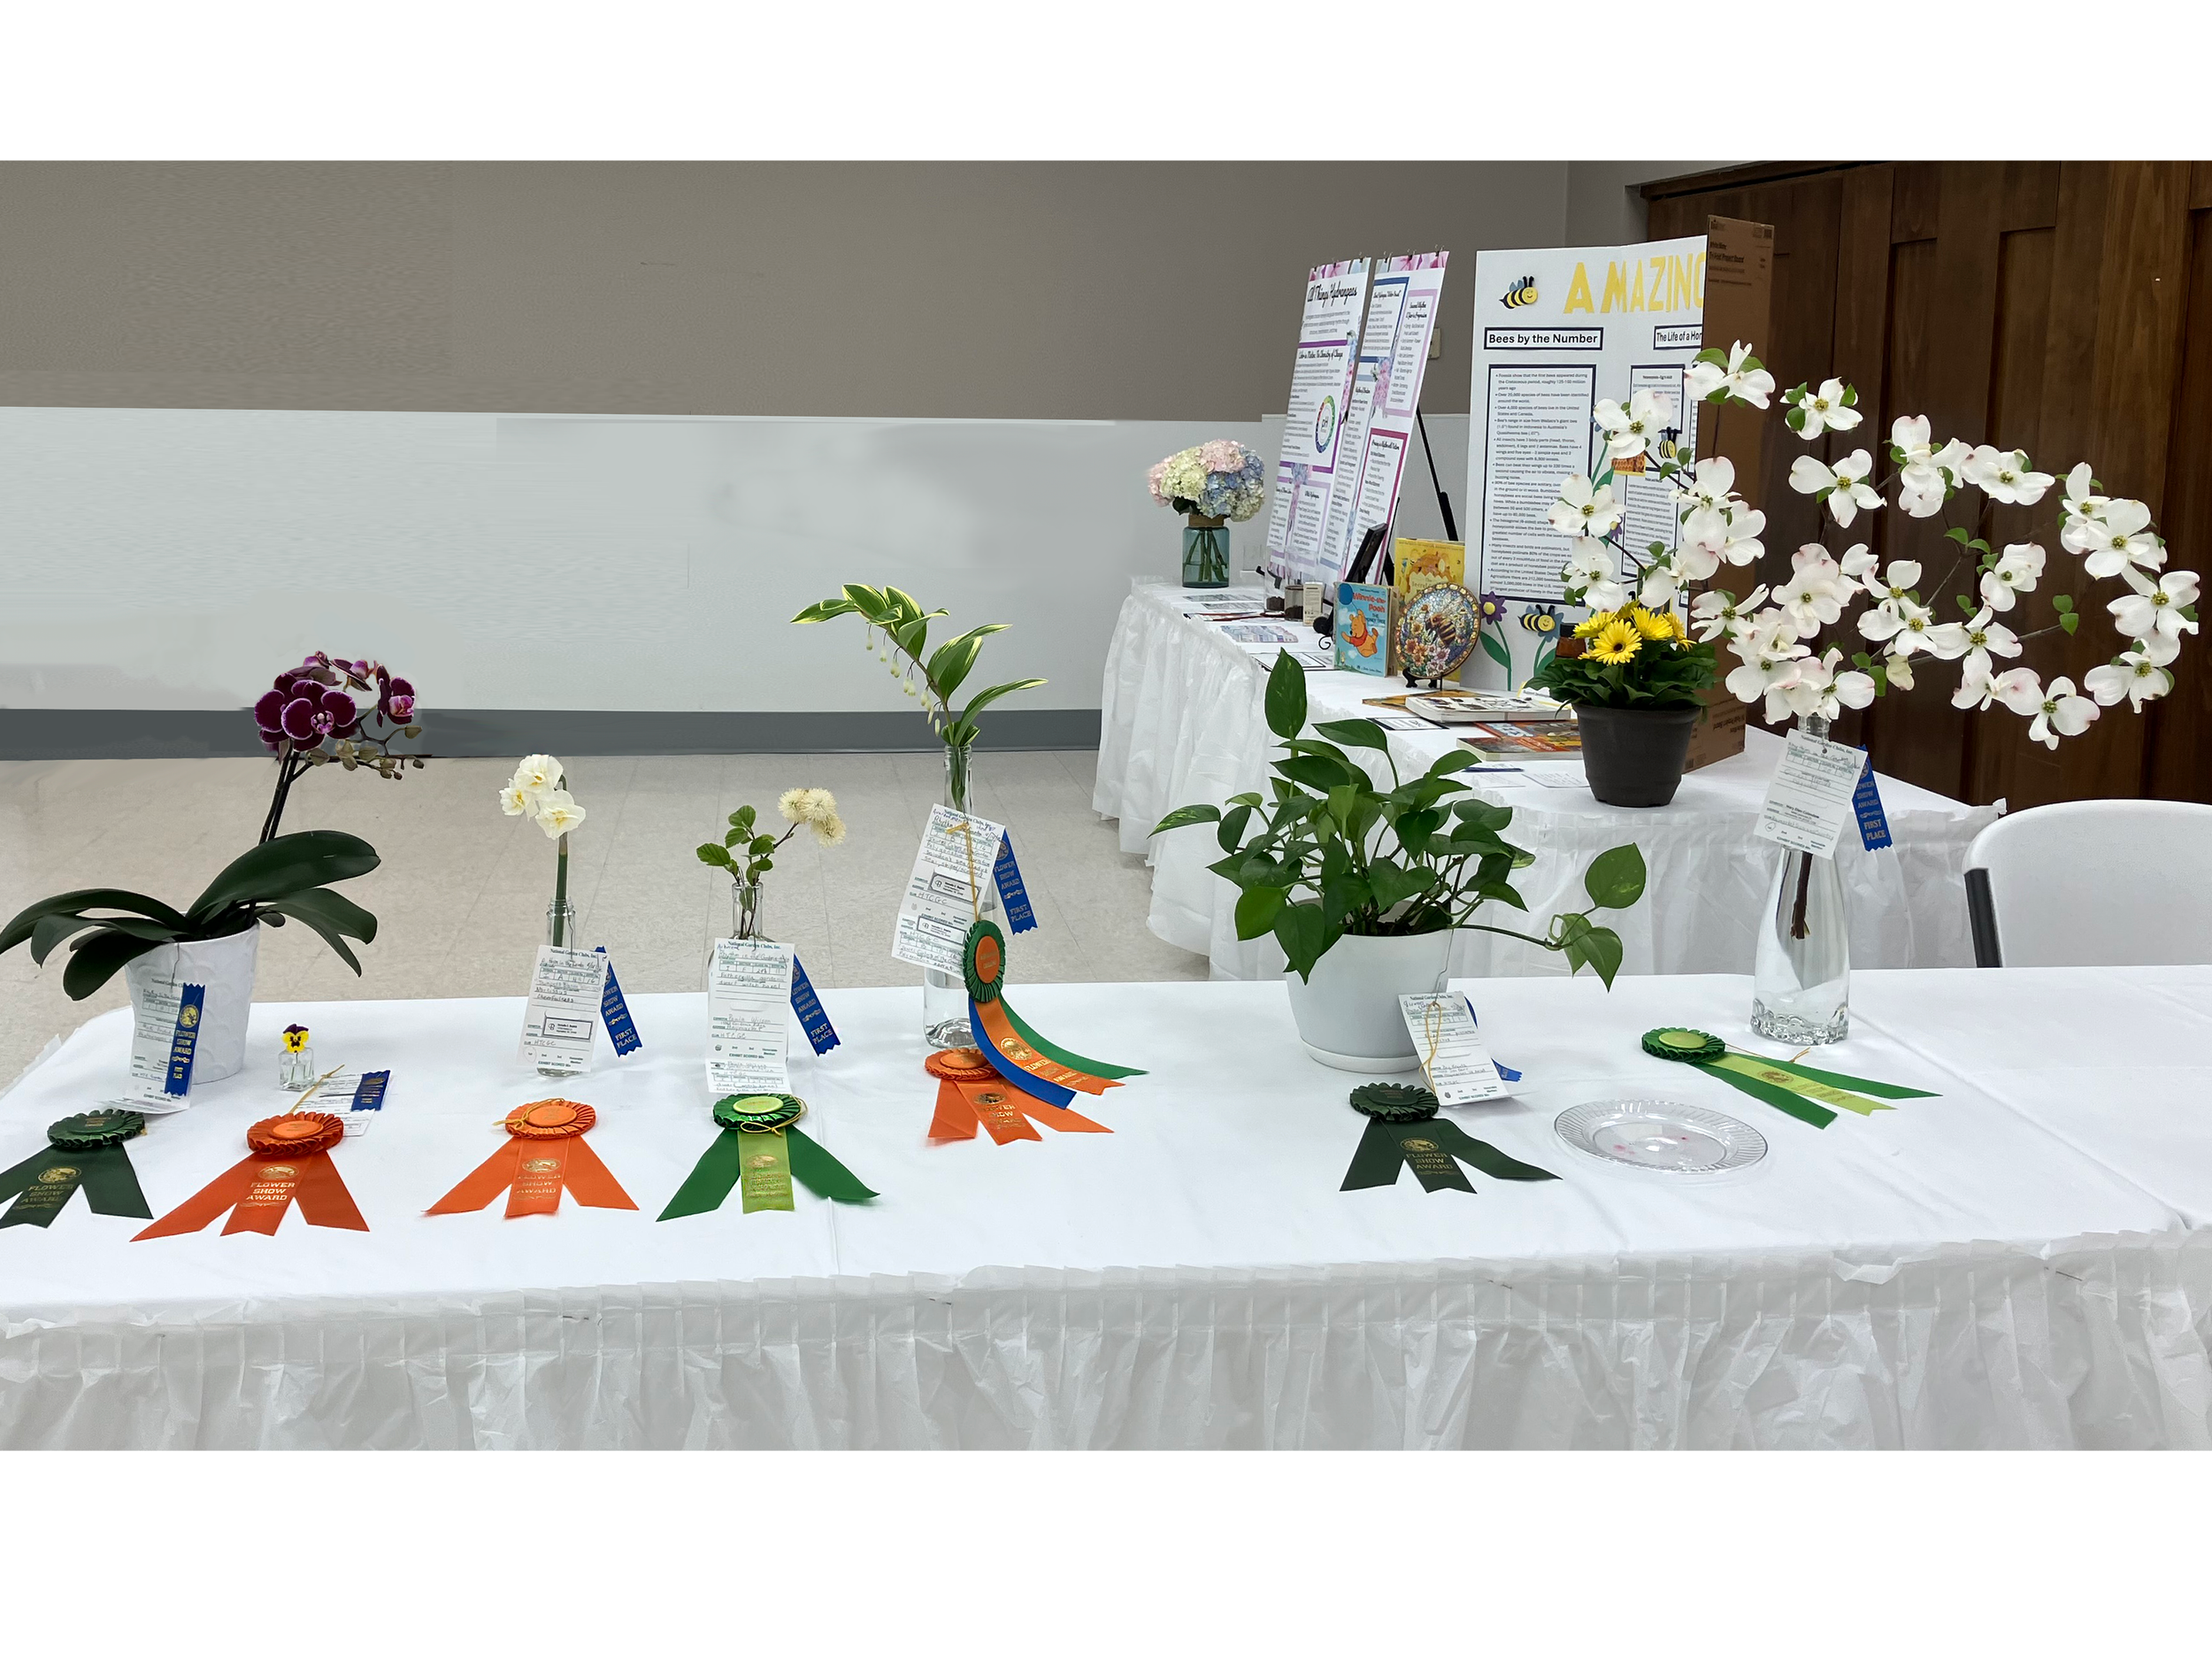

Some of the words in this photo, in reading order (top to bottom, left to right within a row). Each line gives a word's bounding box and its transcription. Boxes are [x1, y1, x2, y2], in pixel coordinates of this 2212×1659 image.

[1489, 334, 1515, 344] Bees
[1517, 334, 1530, 345] by
[1532, 334, 1550, 343] the
[1553, 334, 1598, 344] Number
[1657, 332, 1666, 342] The
[1668, 331, 1678, 342] Life
[1679, 331, 1686, 341] of
[1369, 604, 1385, 613] Pooh
[1858, 799, 1879, 809] AWARD
[1864, 820, 1882, 830] FIRST
[1866, 830, 1886, 841] PLACE
[994, 862, 1016, 873] FLOWER
[1001, 878, 1020, 889] AWARD
[1009, 904, 1027, 915] FIRST
[1011, 911, 1032, 922] PLACE
[605, 1003, 623, 1016] AWARD
[798, 999, 816, 1013] AWARD
[615, 1028, 633, 1040] FIRST
[810, 1023, 828, 1037] FIRST
[617, 1035, 637, 1048] PLACE
[813, 1030, 833, 1044] PLACE
[1024, 1059, 1052, 1071] FLOWER
